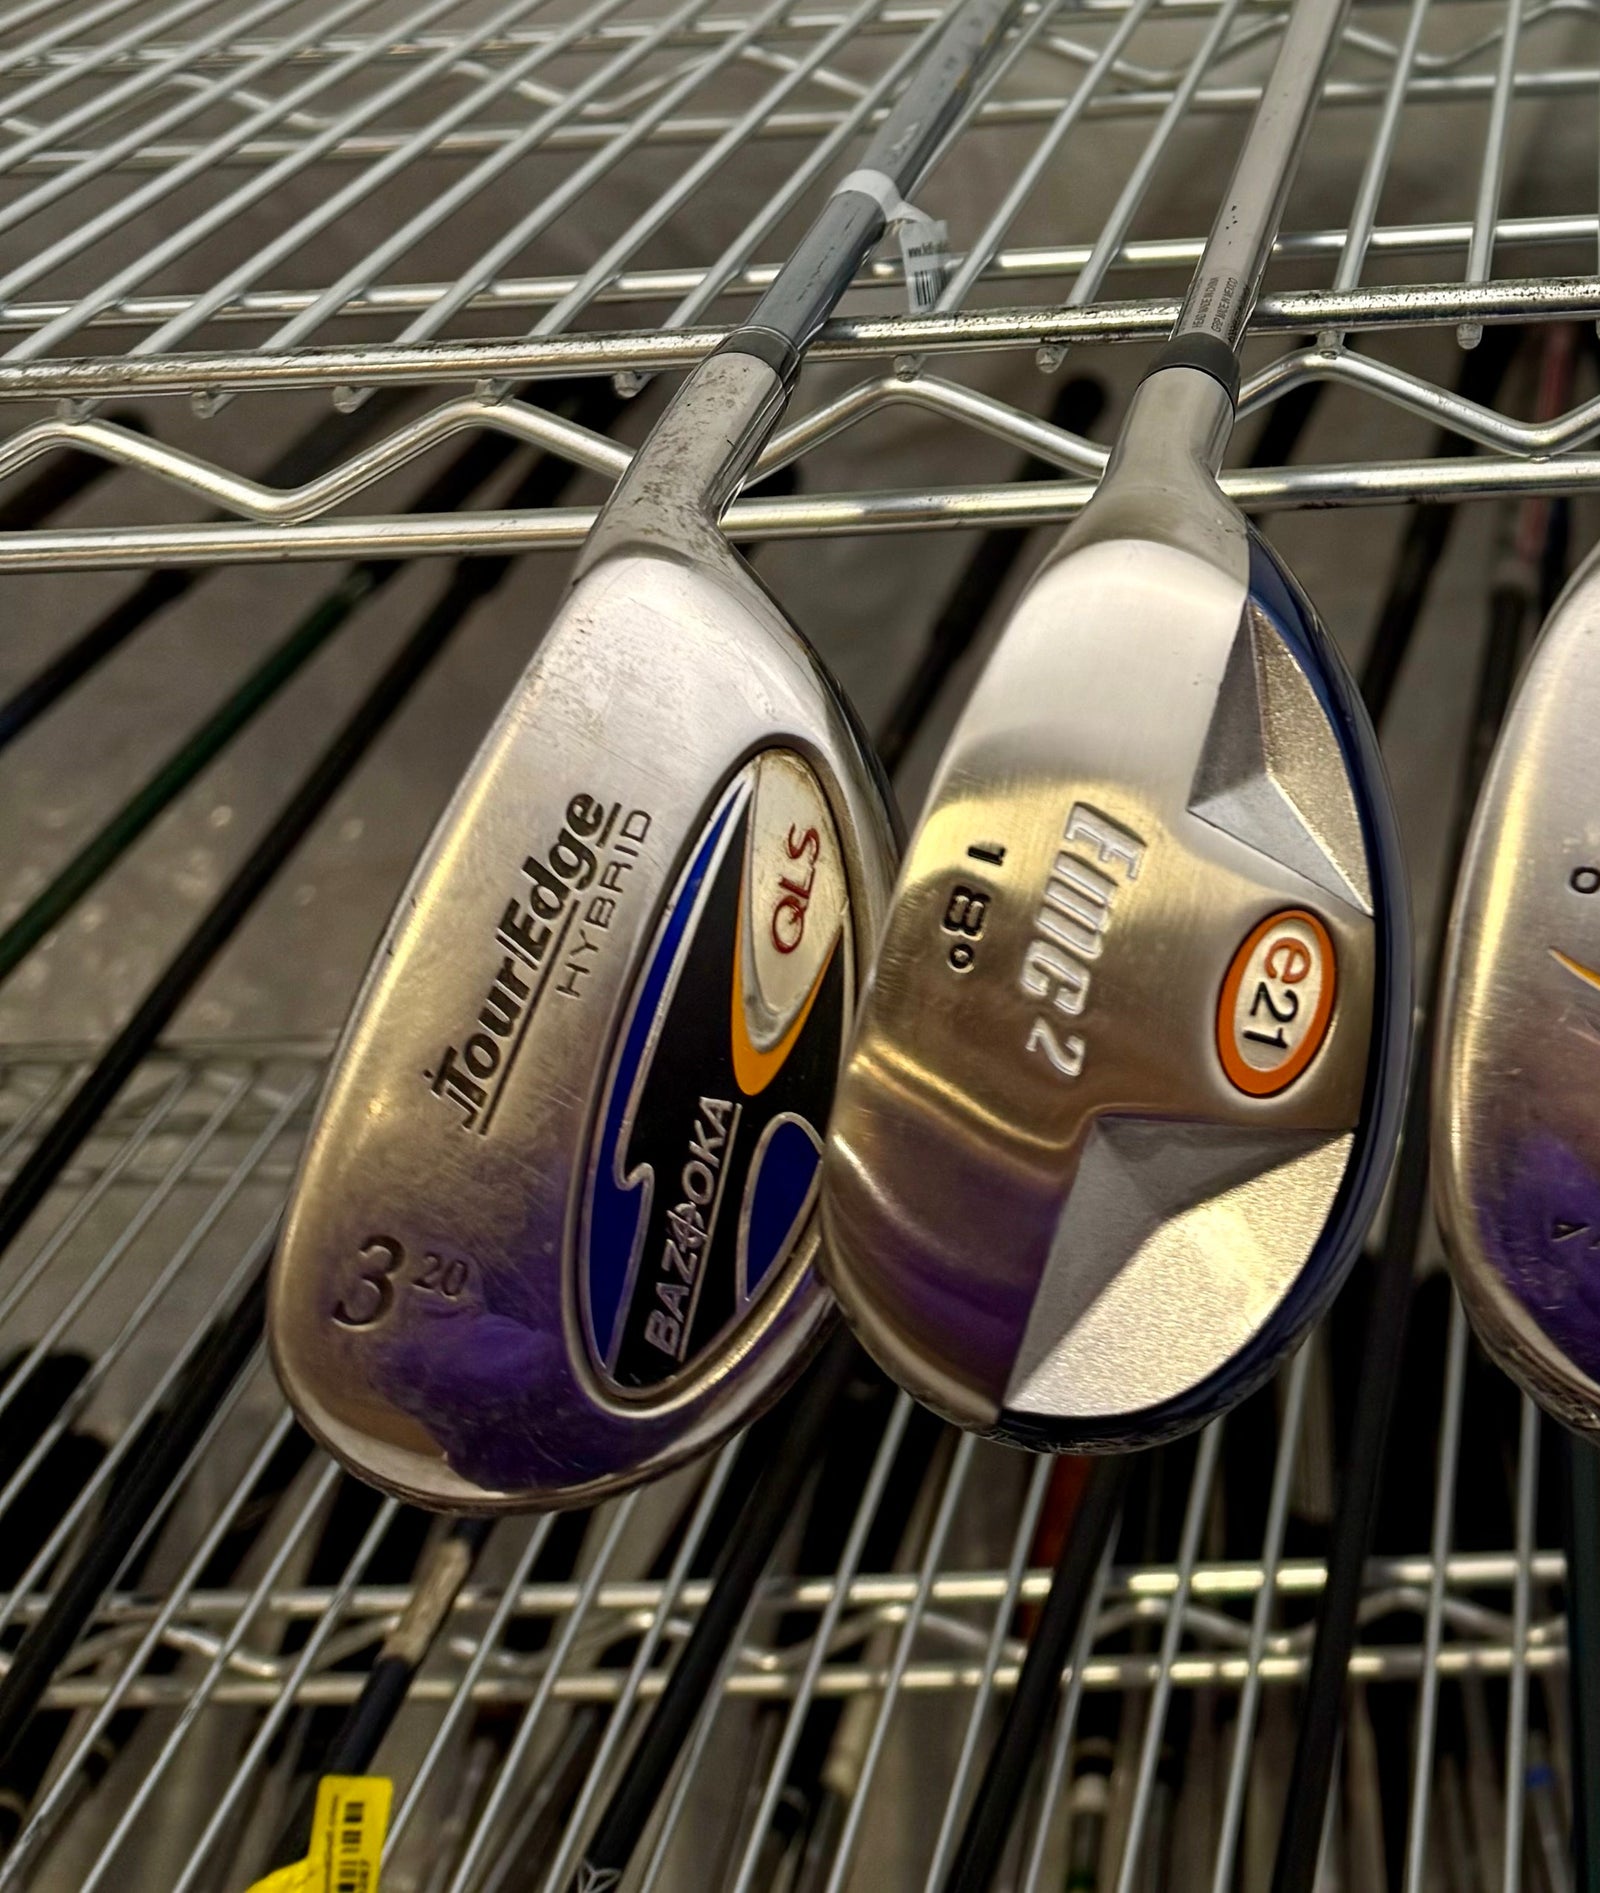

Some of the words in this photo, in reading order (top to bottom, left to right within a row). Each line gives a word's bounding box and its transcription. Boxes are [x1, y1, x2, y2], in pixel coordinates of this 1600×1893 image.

[555, 809, 653, 1000] HYBRID
[770, 822, 821, 954] QLS
[331, 1233, 406, 1333] 3
[411, 1252, 470, 1299] 20
[643, 1096, 736, 1357] BAZOOKA
